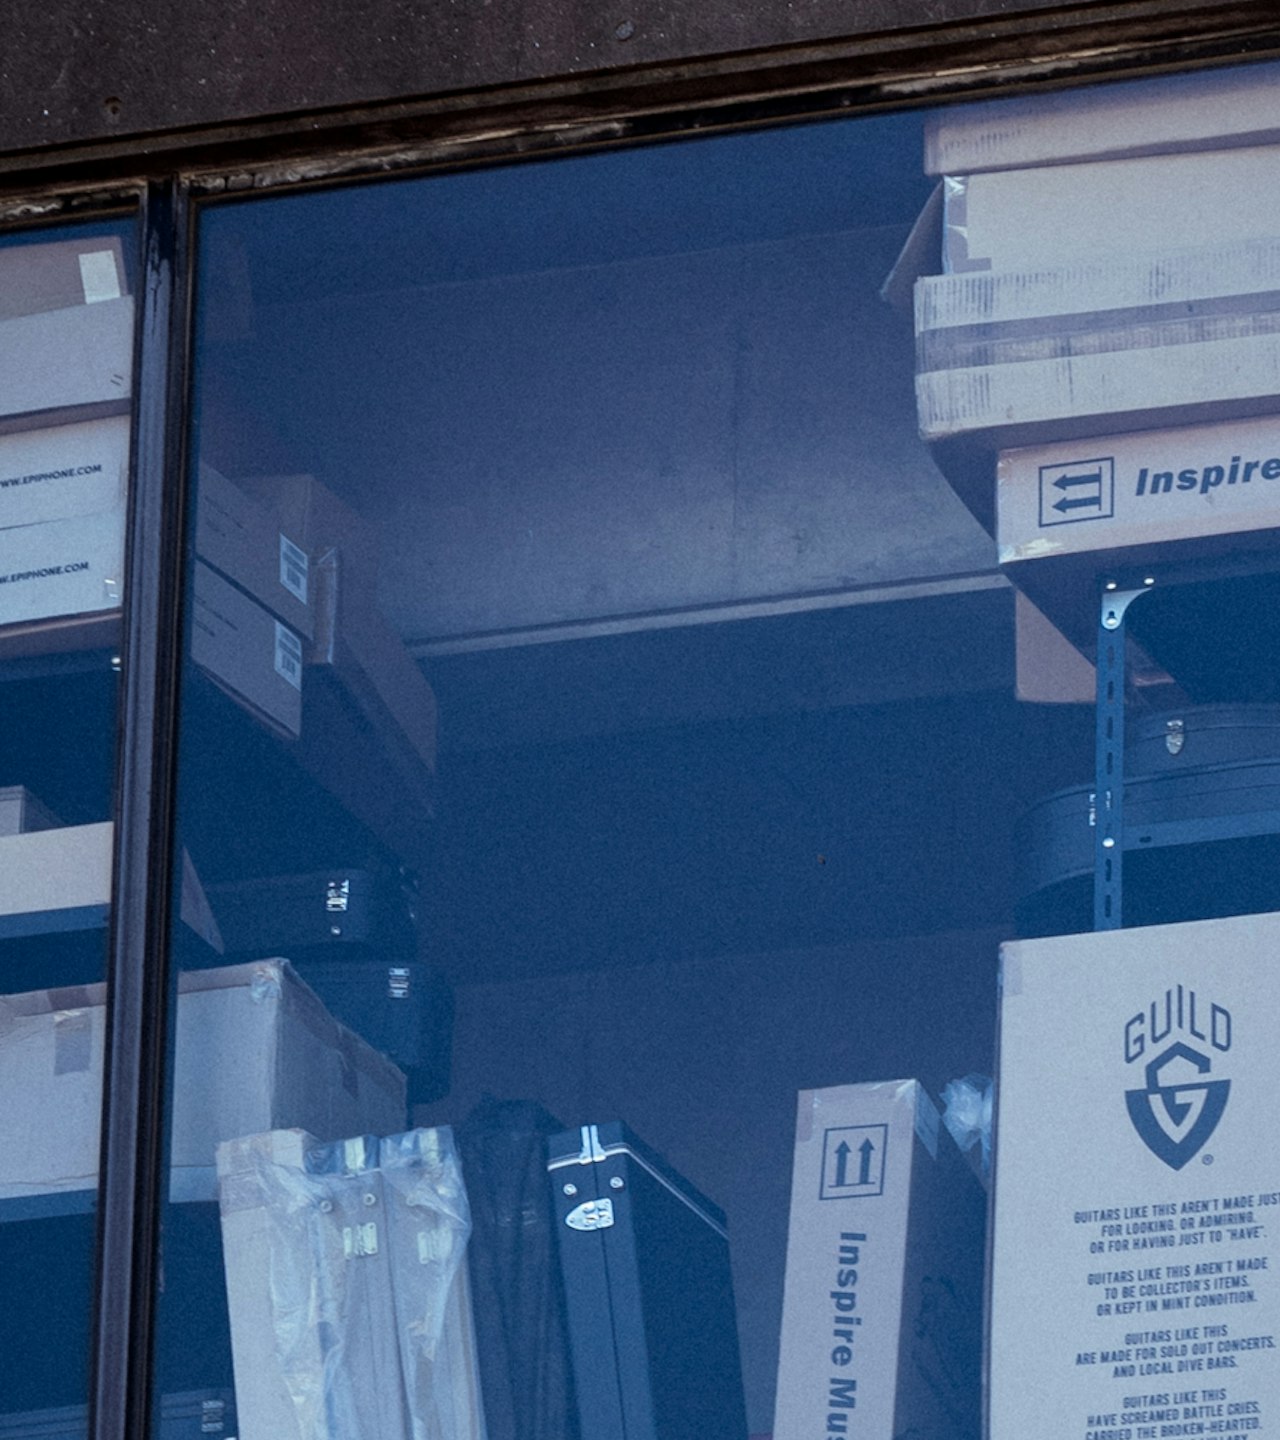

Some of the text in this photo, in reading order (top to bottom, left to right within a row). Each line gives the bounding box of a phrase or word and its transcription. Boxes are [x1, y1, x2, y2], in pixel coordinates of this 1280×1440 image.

[1124, 984, 1231, 1064] GUILD
[1074, 1208, 1120, 1224] GUITARS
[1124, 1205, 1148, 1220] LIKE
[1152, 1203, 1177, 1217] THIS
[1180, 1199, 1219, 1214] AREN'T
[1223, 1195, 1254, 1210] MADE
[1101, 1224, 1123, 1237] FOR
[1180, 1217, 1195, 1230] OR
[1089, 1241, 1104, 1254] OR
[1108, 1239, 1129, 1252] FOR
[1133, 1235, 1175, 1250] HAVING
[1178, 1231, 1205, 1246] JUST
[1209, 1230, 1222, 1243] TO
[1087, 1257, 1268, 1286] GUITARS LIKE THIS AREN'T MADE
[830, 1232, 867, 1366] Inspire
[1104, 1287, 1118, 1300] TO
[1122, 1285, 1136, 1299] BE
[1139, 1279, 1211, 1297] COLLECTOR'S
[1096, 1303, 1112, 1316] OR
[1115, 1301, 1142, 1314] KEPT
[1145, 1300, 1158, 1312] IN
[1162, 1296, 1191, 1310] MINT
[1125, 1324, 1228, 1345] GUITARS LIKE THIS
[1076, 1352, 1097, 1365] ARE
[1100, 1349, 1132, 1363] MADE
[1135, 1347, 1157, 1360] FOR
[1160, 1344, 1188, 1358] SOLD
[1191, 1341, 1214, 1355] OUT
[1113, 1364, 1136, 1378] AND
[1139, 1362, 1174, 1376] LOCAL
[1177, 1358, 1204, 1373] DIVE
[1123, 1388, 1227, 1409] GUITARS LIKE THIS
[1087, 1413, 1117, 1427] HAVE
[1121, 1408, 1179, 1425] SCREAMED
[1183, 1404, 1223, 1420] BATTLE
[1137, 1426, 1157, 1439] THE
